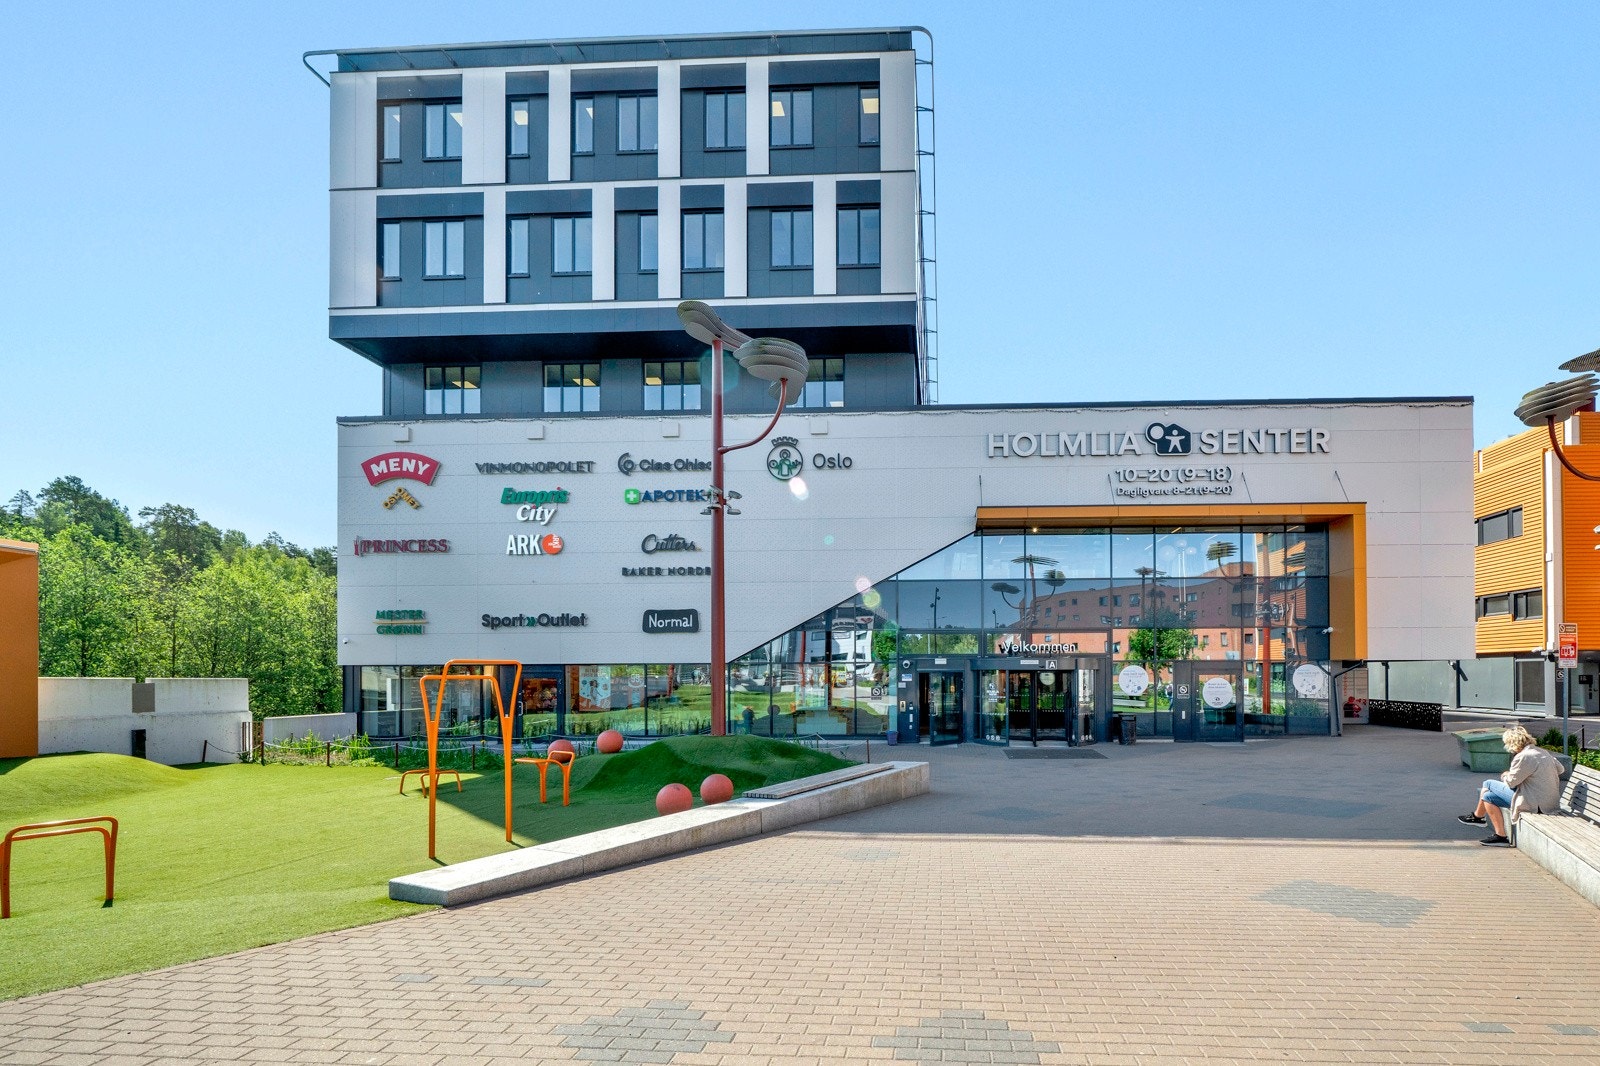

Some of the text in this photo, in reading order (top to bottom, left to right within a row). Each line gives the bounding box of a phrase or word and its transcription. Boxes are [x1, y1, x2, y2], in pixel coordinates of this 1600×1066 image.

[988, 427, 1332, 457] HOLMLIA SENTER
[370, 458, 430, 477] MENY
[475, 461, 596, 473] VINMONOPOLET
[639, 458, 712, 471] Clas Ohlso
[813, 453, 853, 469] Oslo
[500, 486, 570, 508] Europris
[641, 489, 707, 502] APOTEK
[1117, 487, 1171, 499] Dagligvare
[516, 504, 556, 526] City
[361, 539, 449, 554] PRINCESS
[506, 534, 542, 555] ARK
[641, 533, 699, 555] Cutters
[621, 566, 712, 576] BAKER NORDB
[375, 609, 425, 620] MESTER
[648, 614, 693, 628] Normal
[1002, 641, 1076, 652] Velkommen
